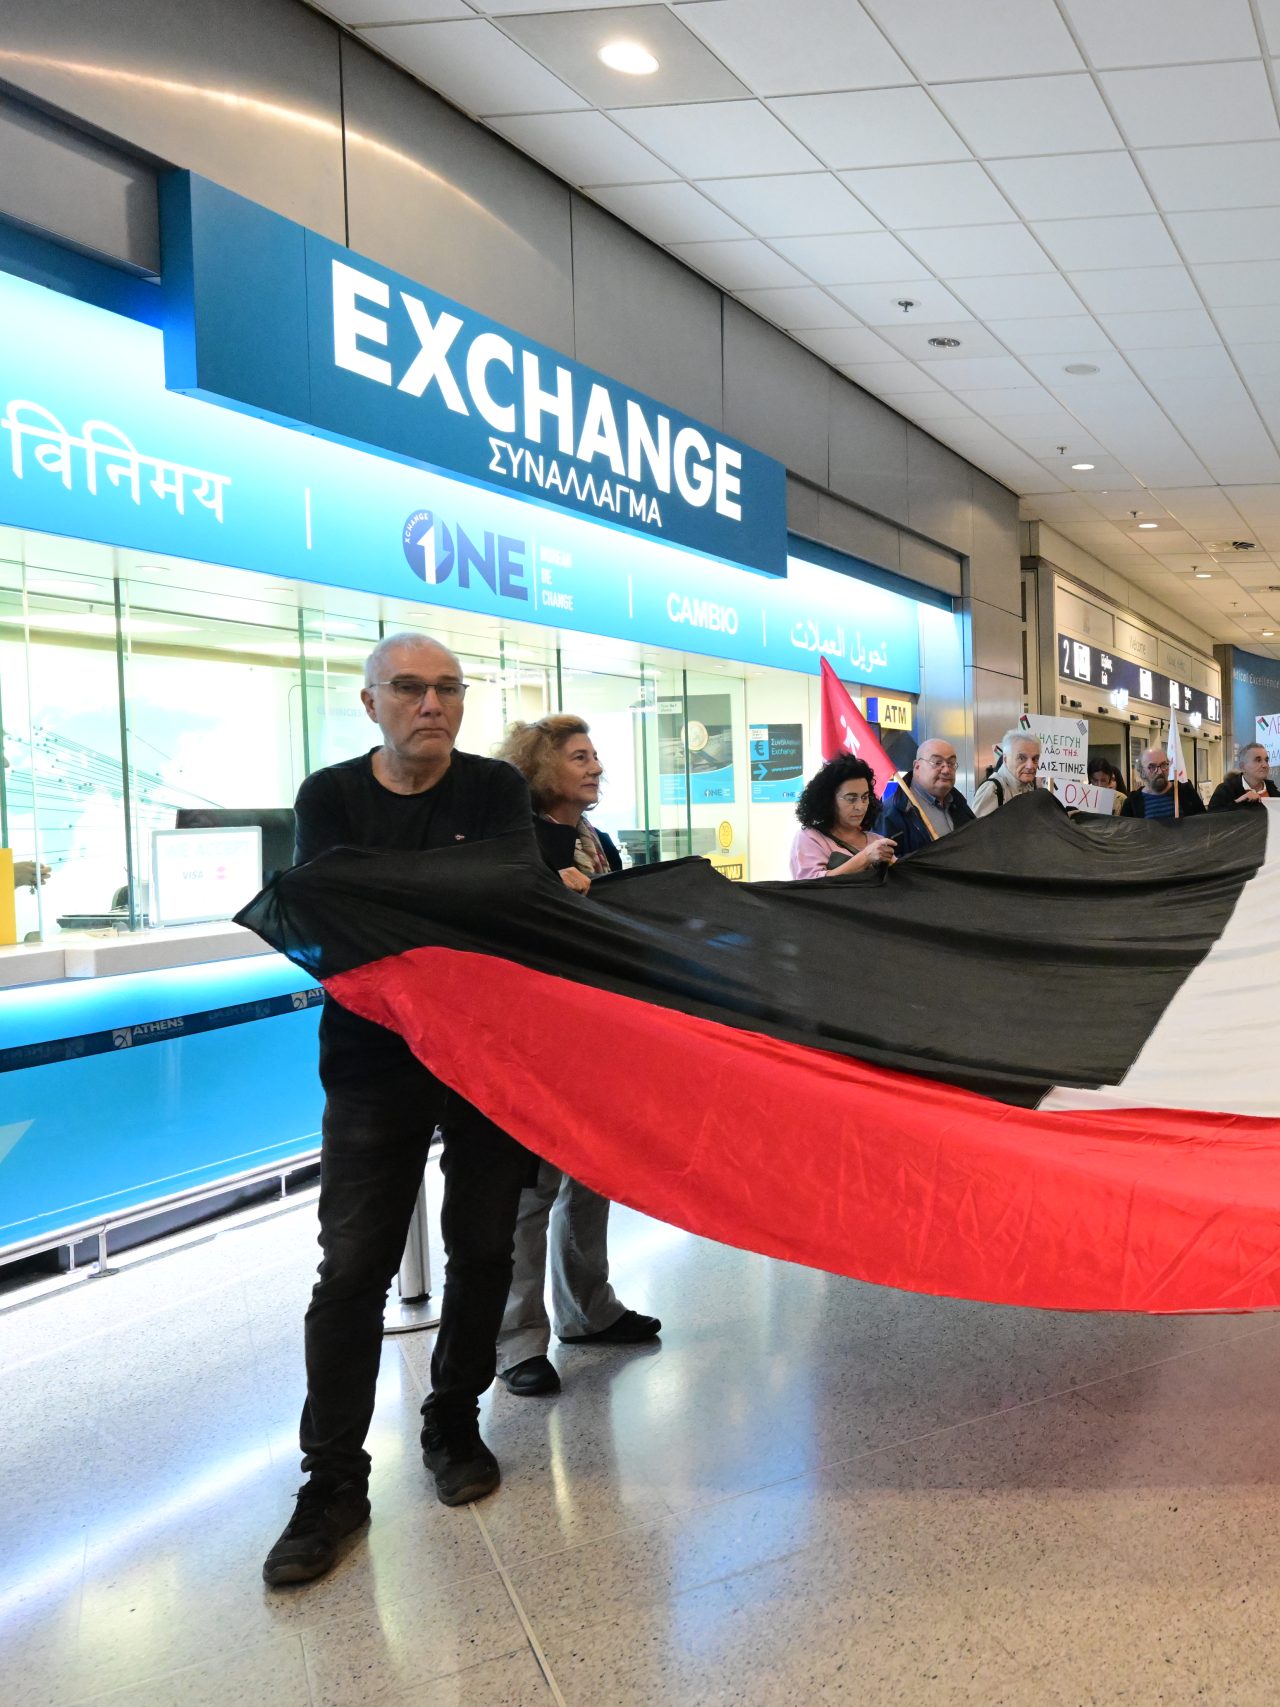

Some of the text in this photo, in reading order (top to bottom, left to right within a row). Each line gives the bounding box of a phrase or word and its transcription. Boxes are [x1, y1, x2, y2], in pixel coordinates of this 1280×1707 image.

[331, 259, 742, 522] EXCHANGE
[1, 399, 232, 524] विनिमय
[488, 436, 663, 528] ΣΥΝΑΛΛΑΓΜΑ
[542, 589, 574, 612] CHANGE
[666, 592, 739, 635] CAMBIO
[1062, 639, 1070, 674] 2
[884, 704, 907, 725] ATM
[1039, 732, 1081, 749] ΗΛΕΓΓΥΗ
[1037, 761, 1086, 775] ΑΙΣΤΙΝΗΣ
[1064, 783, 1099, 809] ΟΧΙ
[133, 1018, 185, 1035] ATHENS
